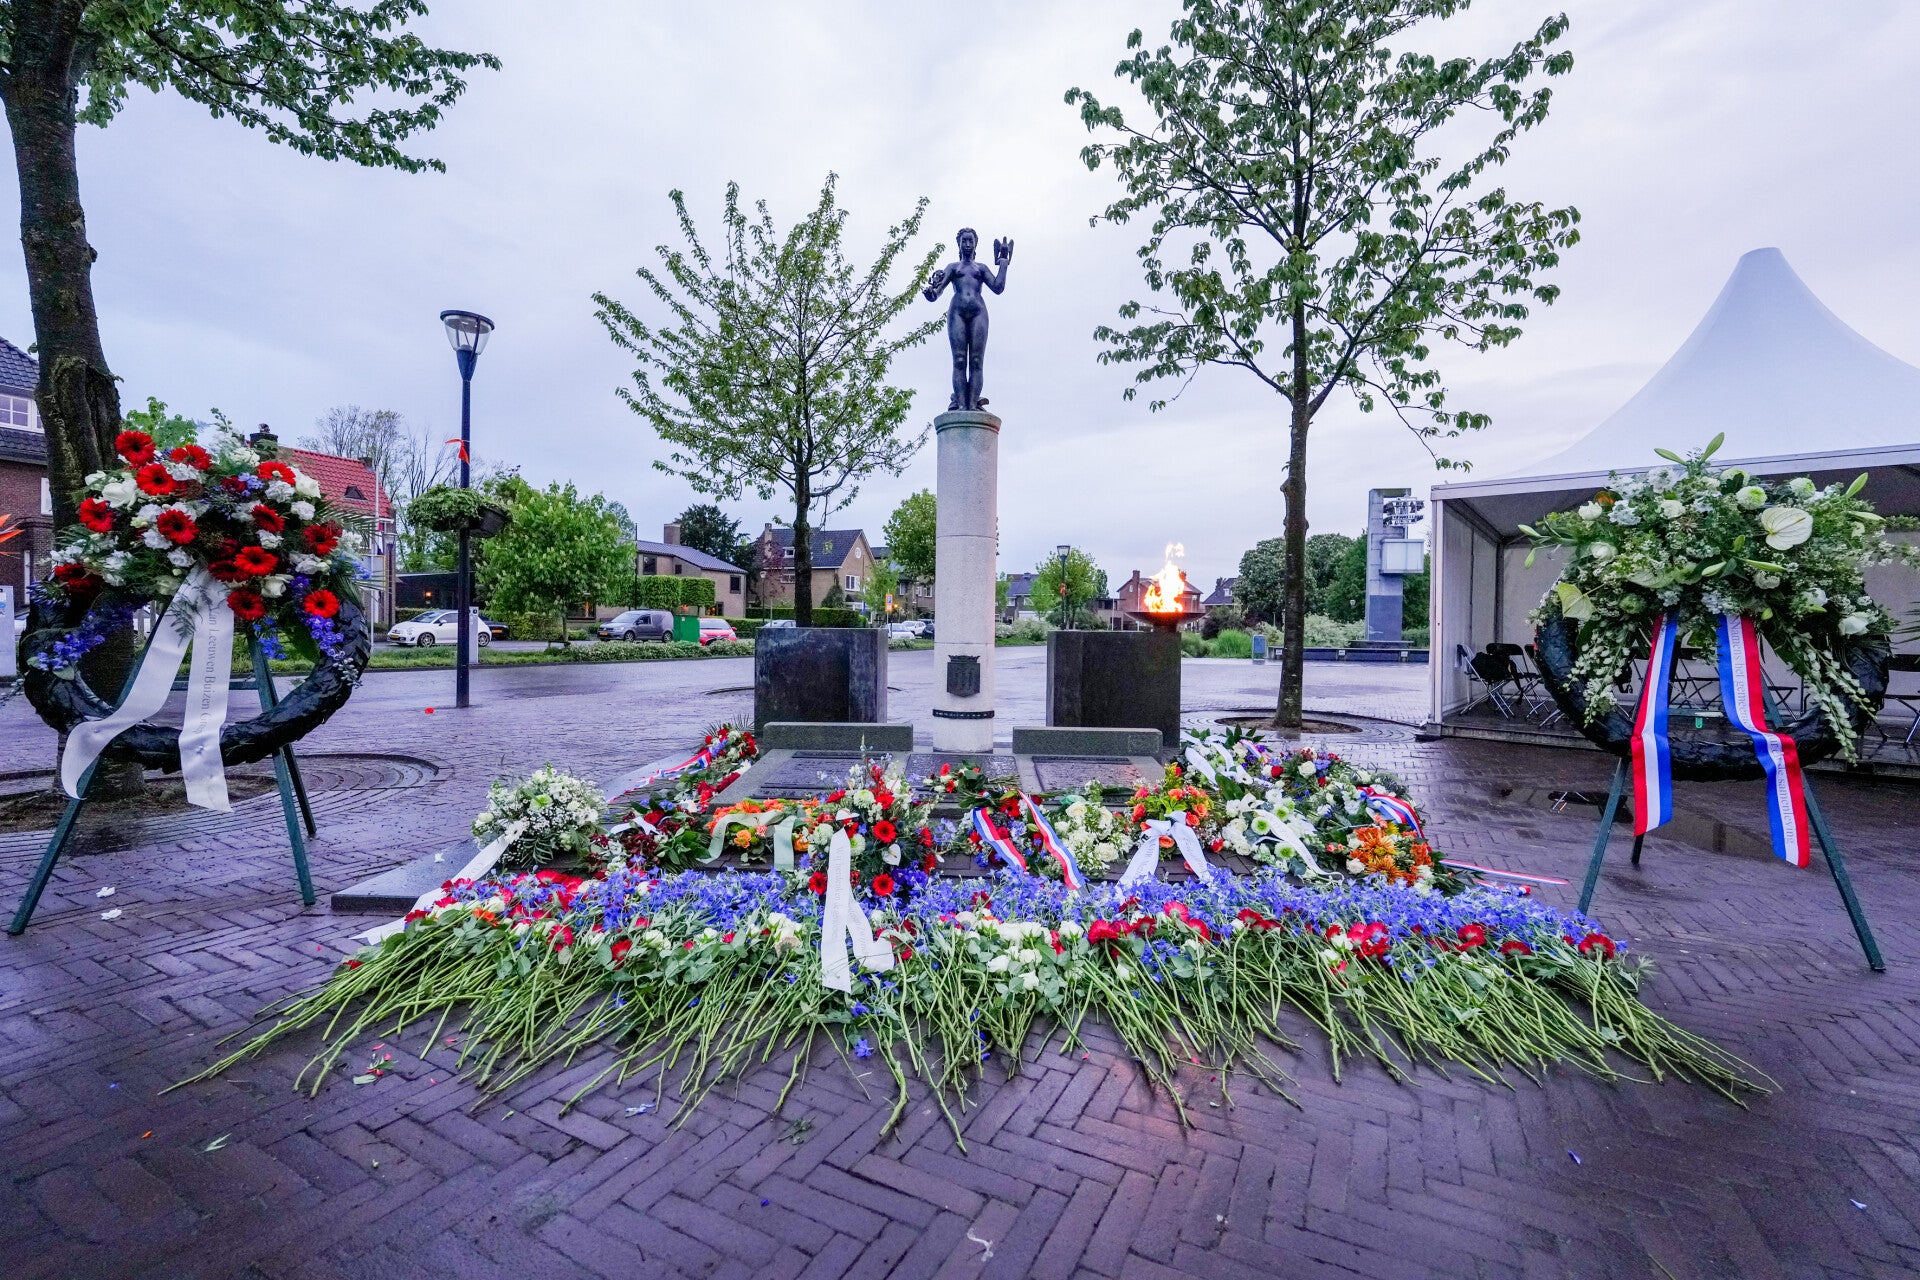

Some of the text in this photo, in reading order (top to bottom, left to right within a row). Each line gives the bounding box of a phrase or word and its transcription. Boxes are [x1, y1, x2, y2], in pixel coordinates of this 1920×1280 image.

[206, 629, 220, 673] Leeuwen
[1729, 621, 1744, 660] Namens
[1735, 663, 1746, 678] het
[201, 676, 216, 710] Buizen
[1778, 778, 1795, 845] samenleving
[833, 863, 844, 901] herdenken
